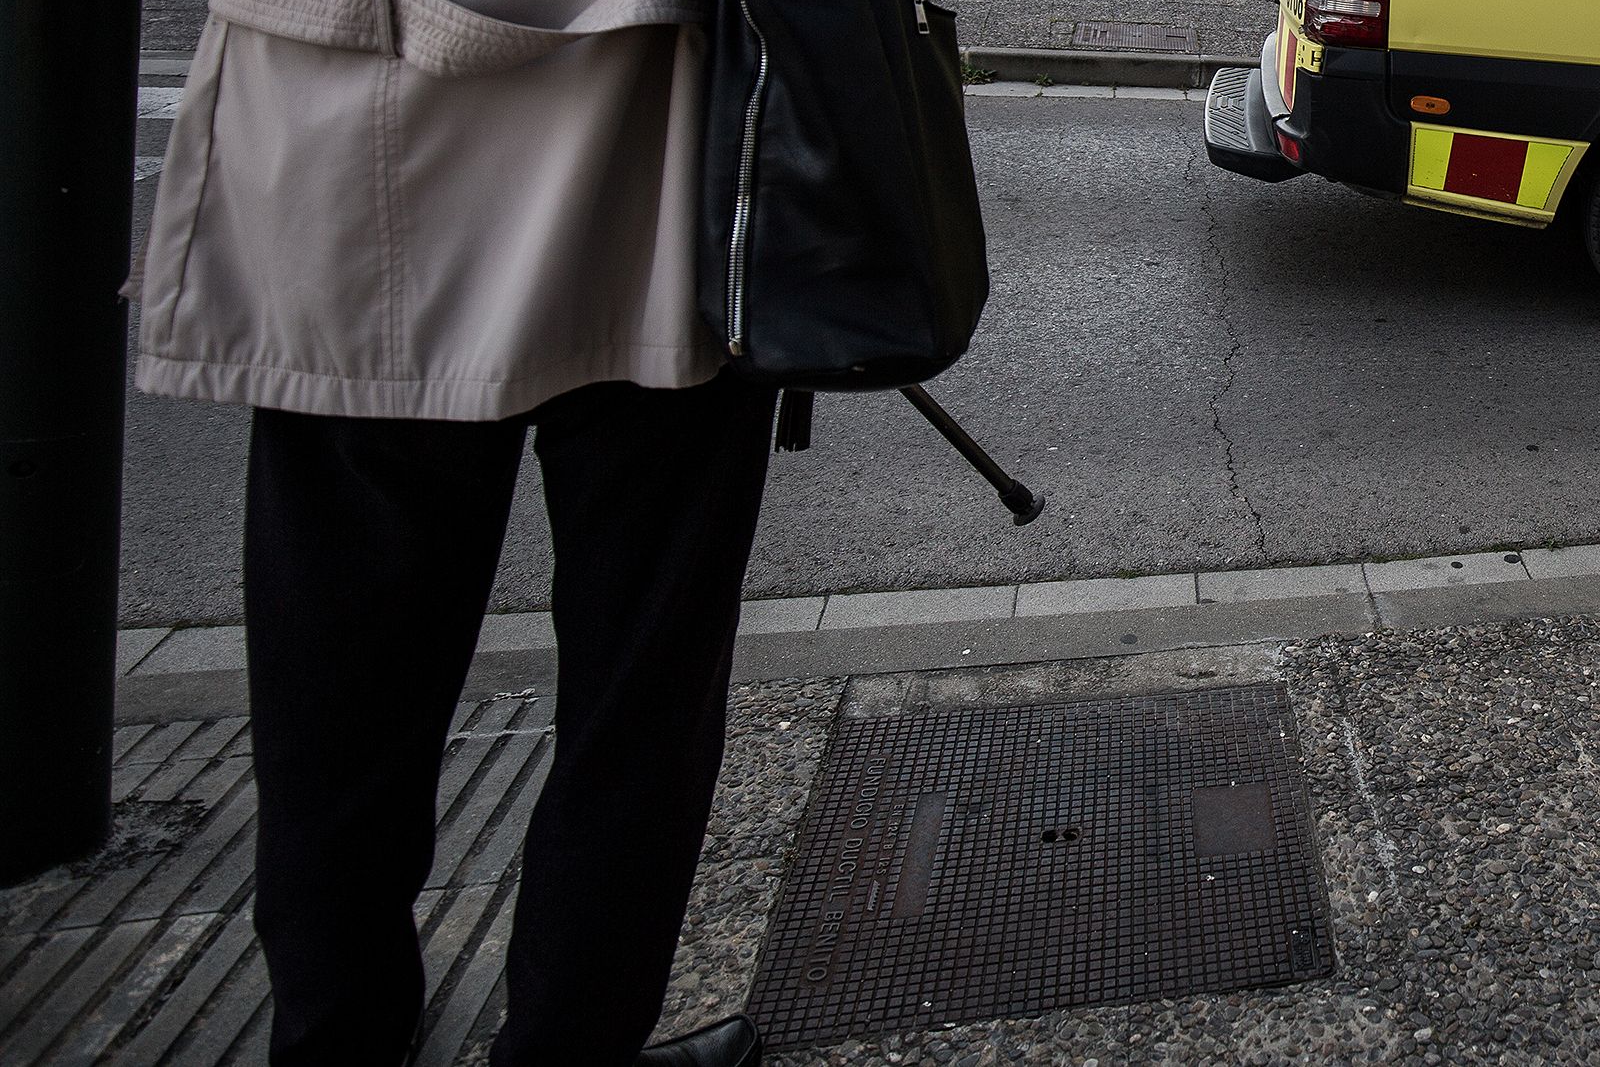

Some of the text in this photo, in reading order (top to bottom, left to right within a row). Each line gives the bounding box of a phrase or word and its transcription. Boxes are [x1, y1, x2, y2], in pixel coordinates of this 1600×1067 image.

[806, 756, 888, 983] FUNDICIO DUCTIL BENITO
